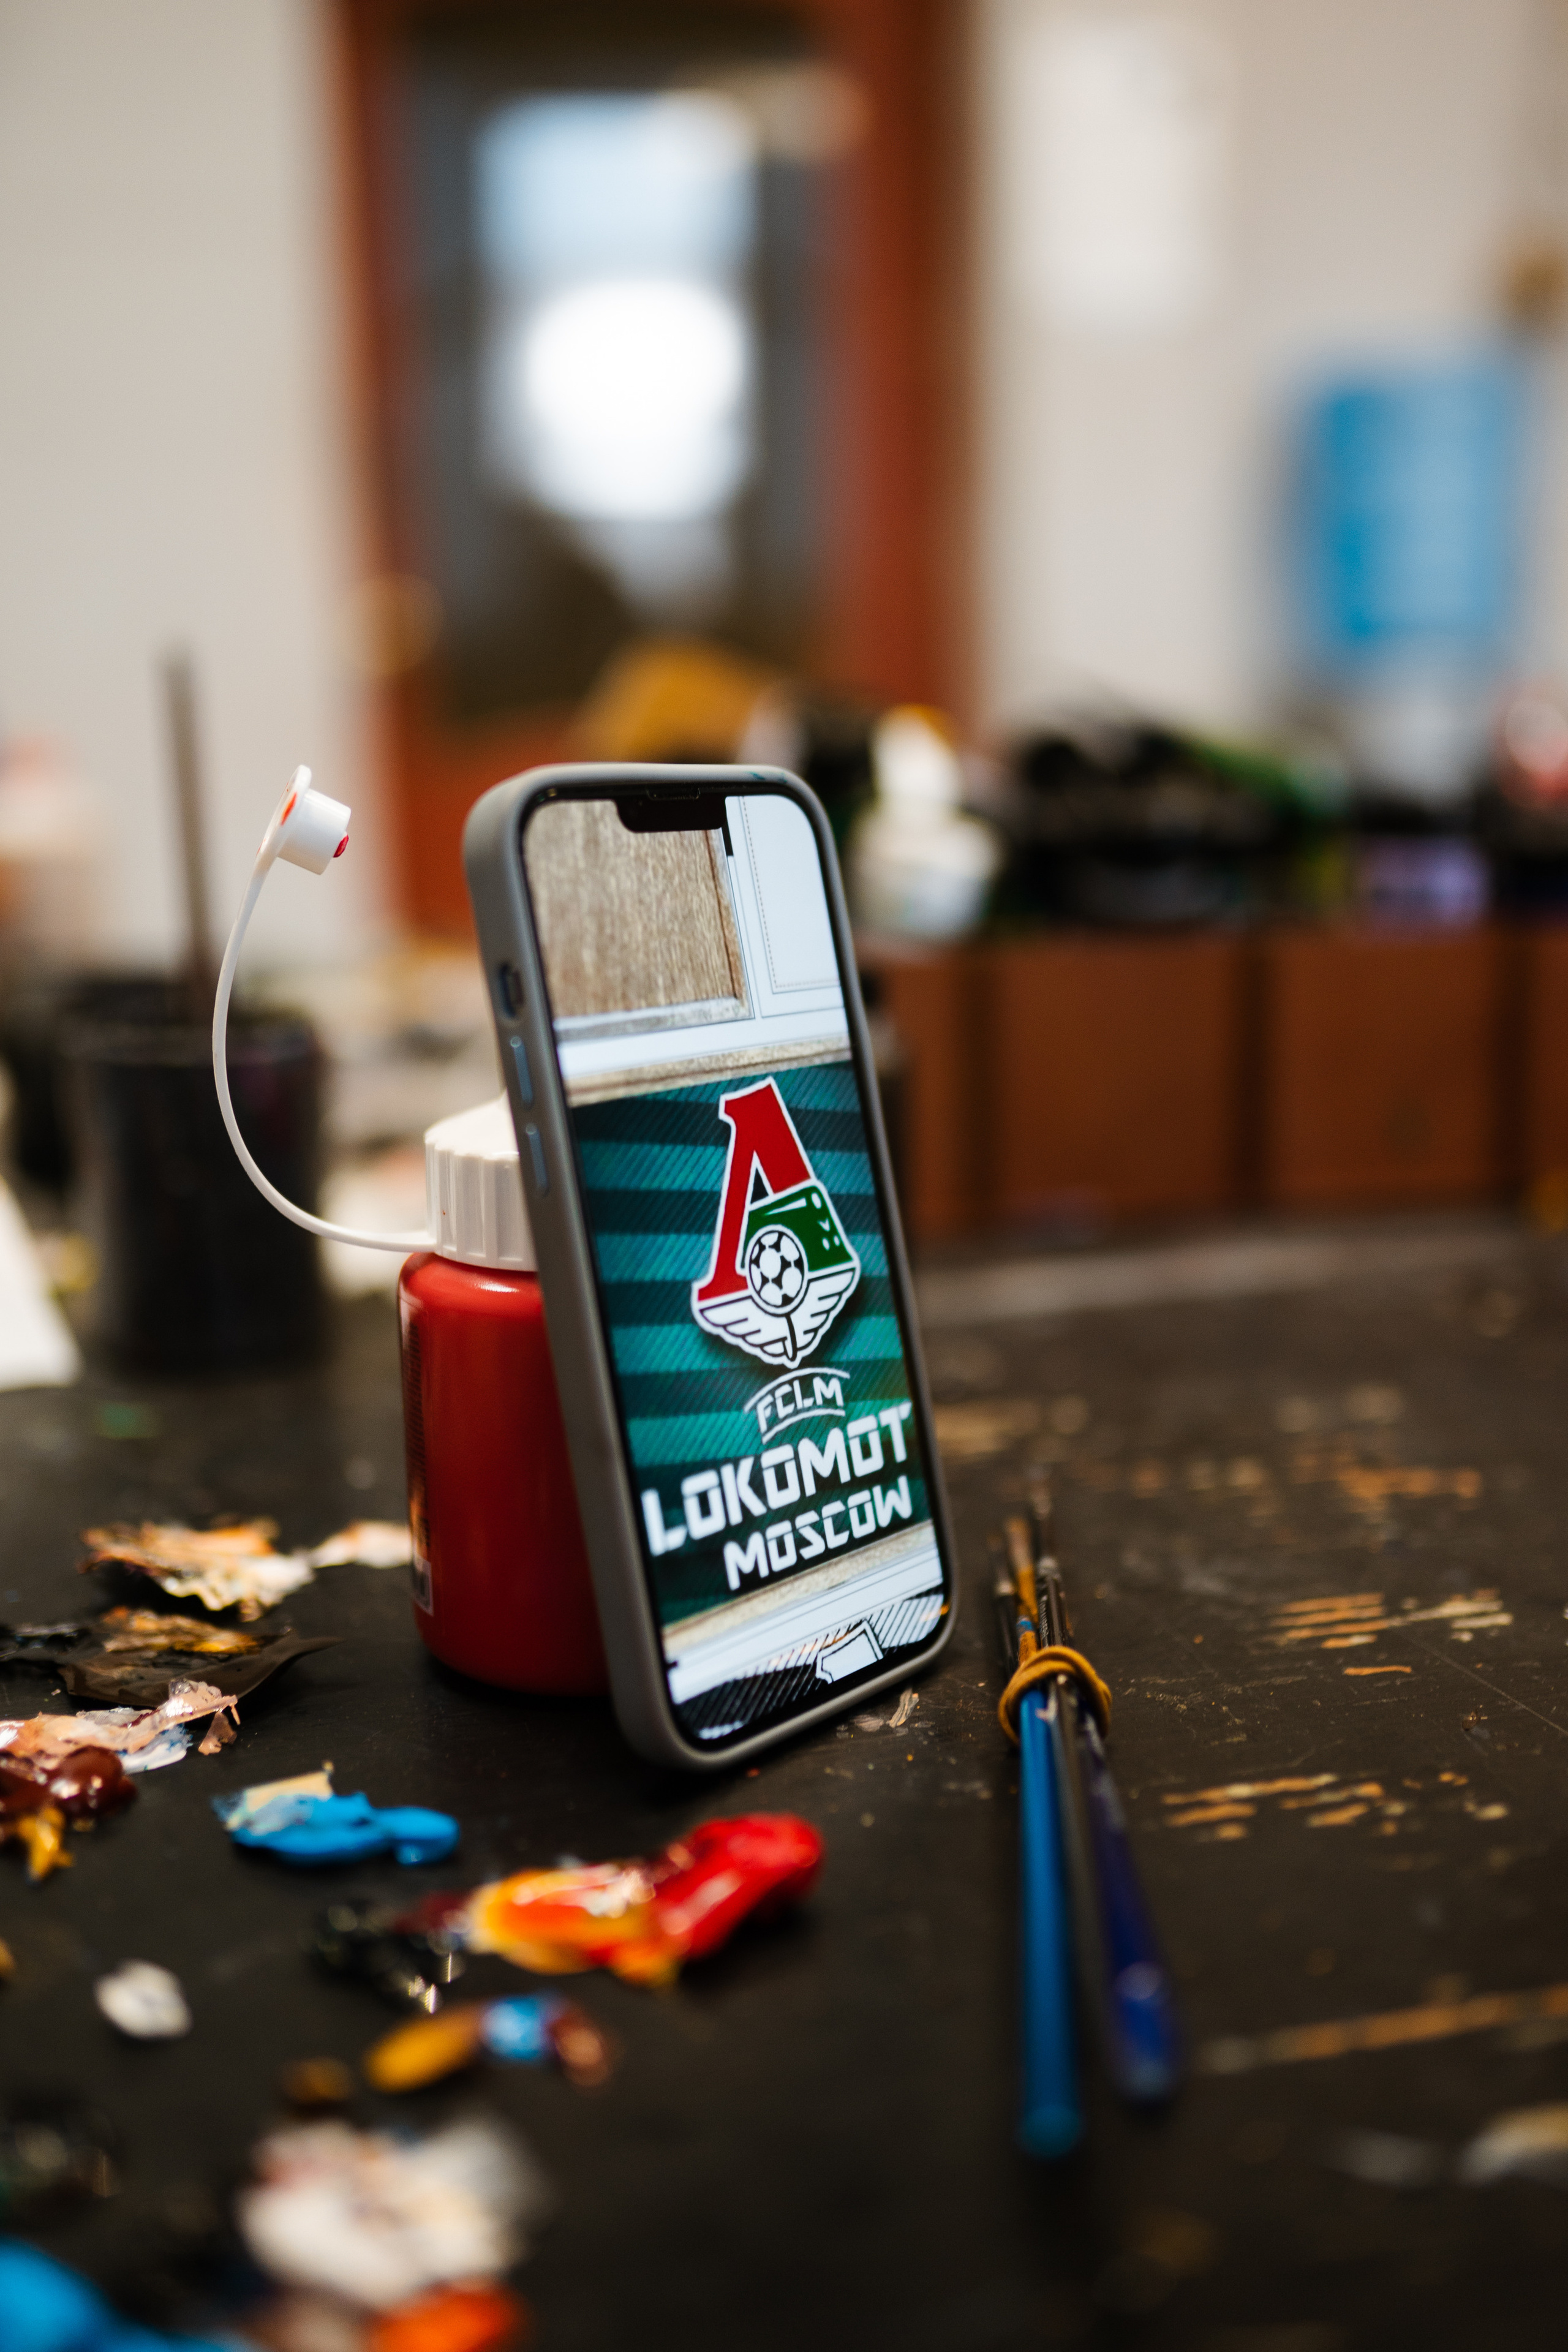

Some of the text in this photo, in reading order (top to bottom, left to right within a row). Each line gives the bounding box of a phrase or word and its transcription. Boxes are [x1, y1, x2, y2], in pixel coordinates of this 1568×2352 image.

[756, 1376, 844, 1433] FCLM
[641, 1401, 913, 1556] LOKOMOT
[723, 1475, 913, 1591] MOSCOW
